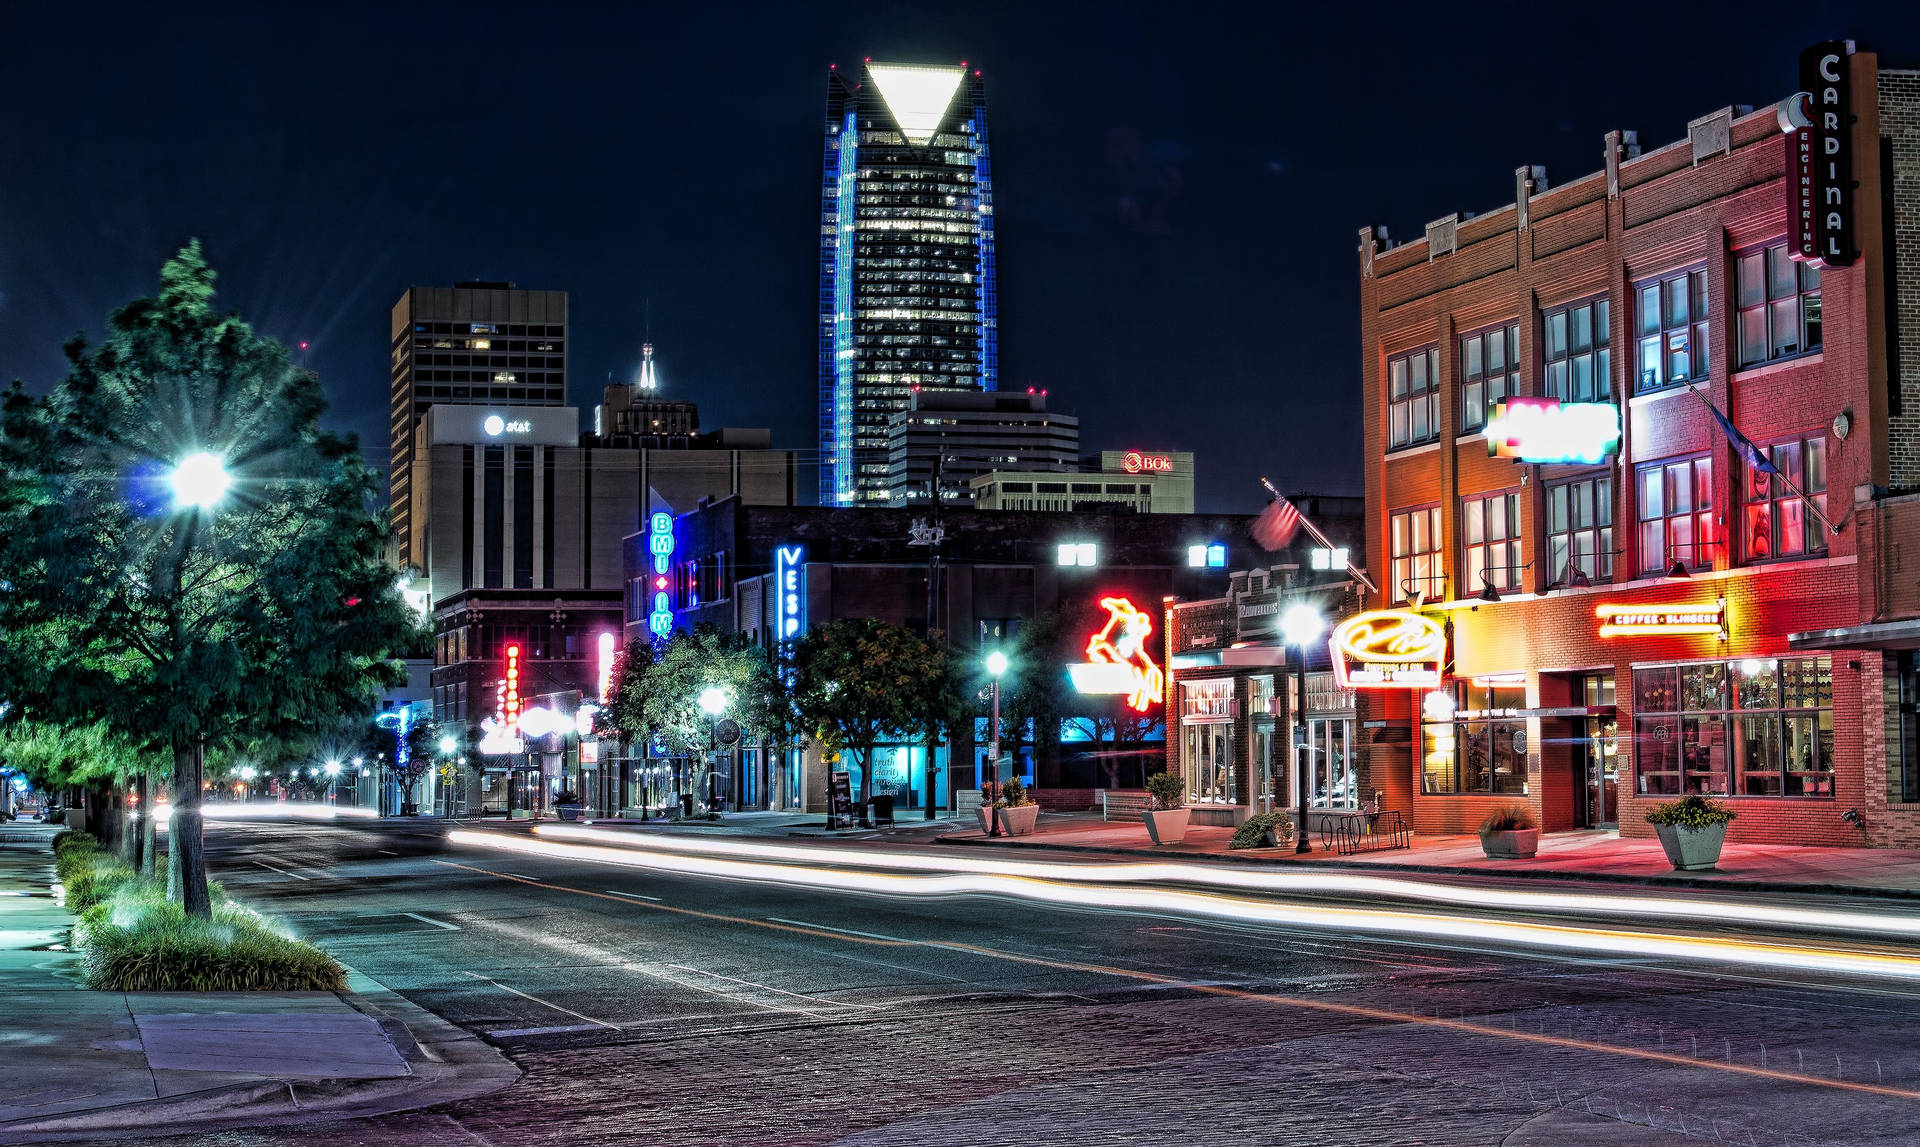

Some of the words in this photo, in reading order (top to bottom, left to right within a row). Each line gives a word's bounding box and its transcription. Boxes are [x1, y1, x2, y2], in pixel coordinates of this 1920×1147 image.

[1819, 54, 1842, 255] CARDINAL
[1800, 132, 1812, 252] ENGINEERING
[1615, 614, 1659, 625] COFFEE
[874, 757, 895, 767] truth
[873, 767, 899, 779] clarity
[875, 787, 899, 797] design
